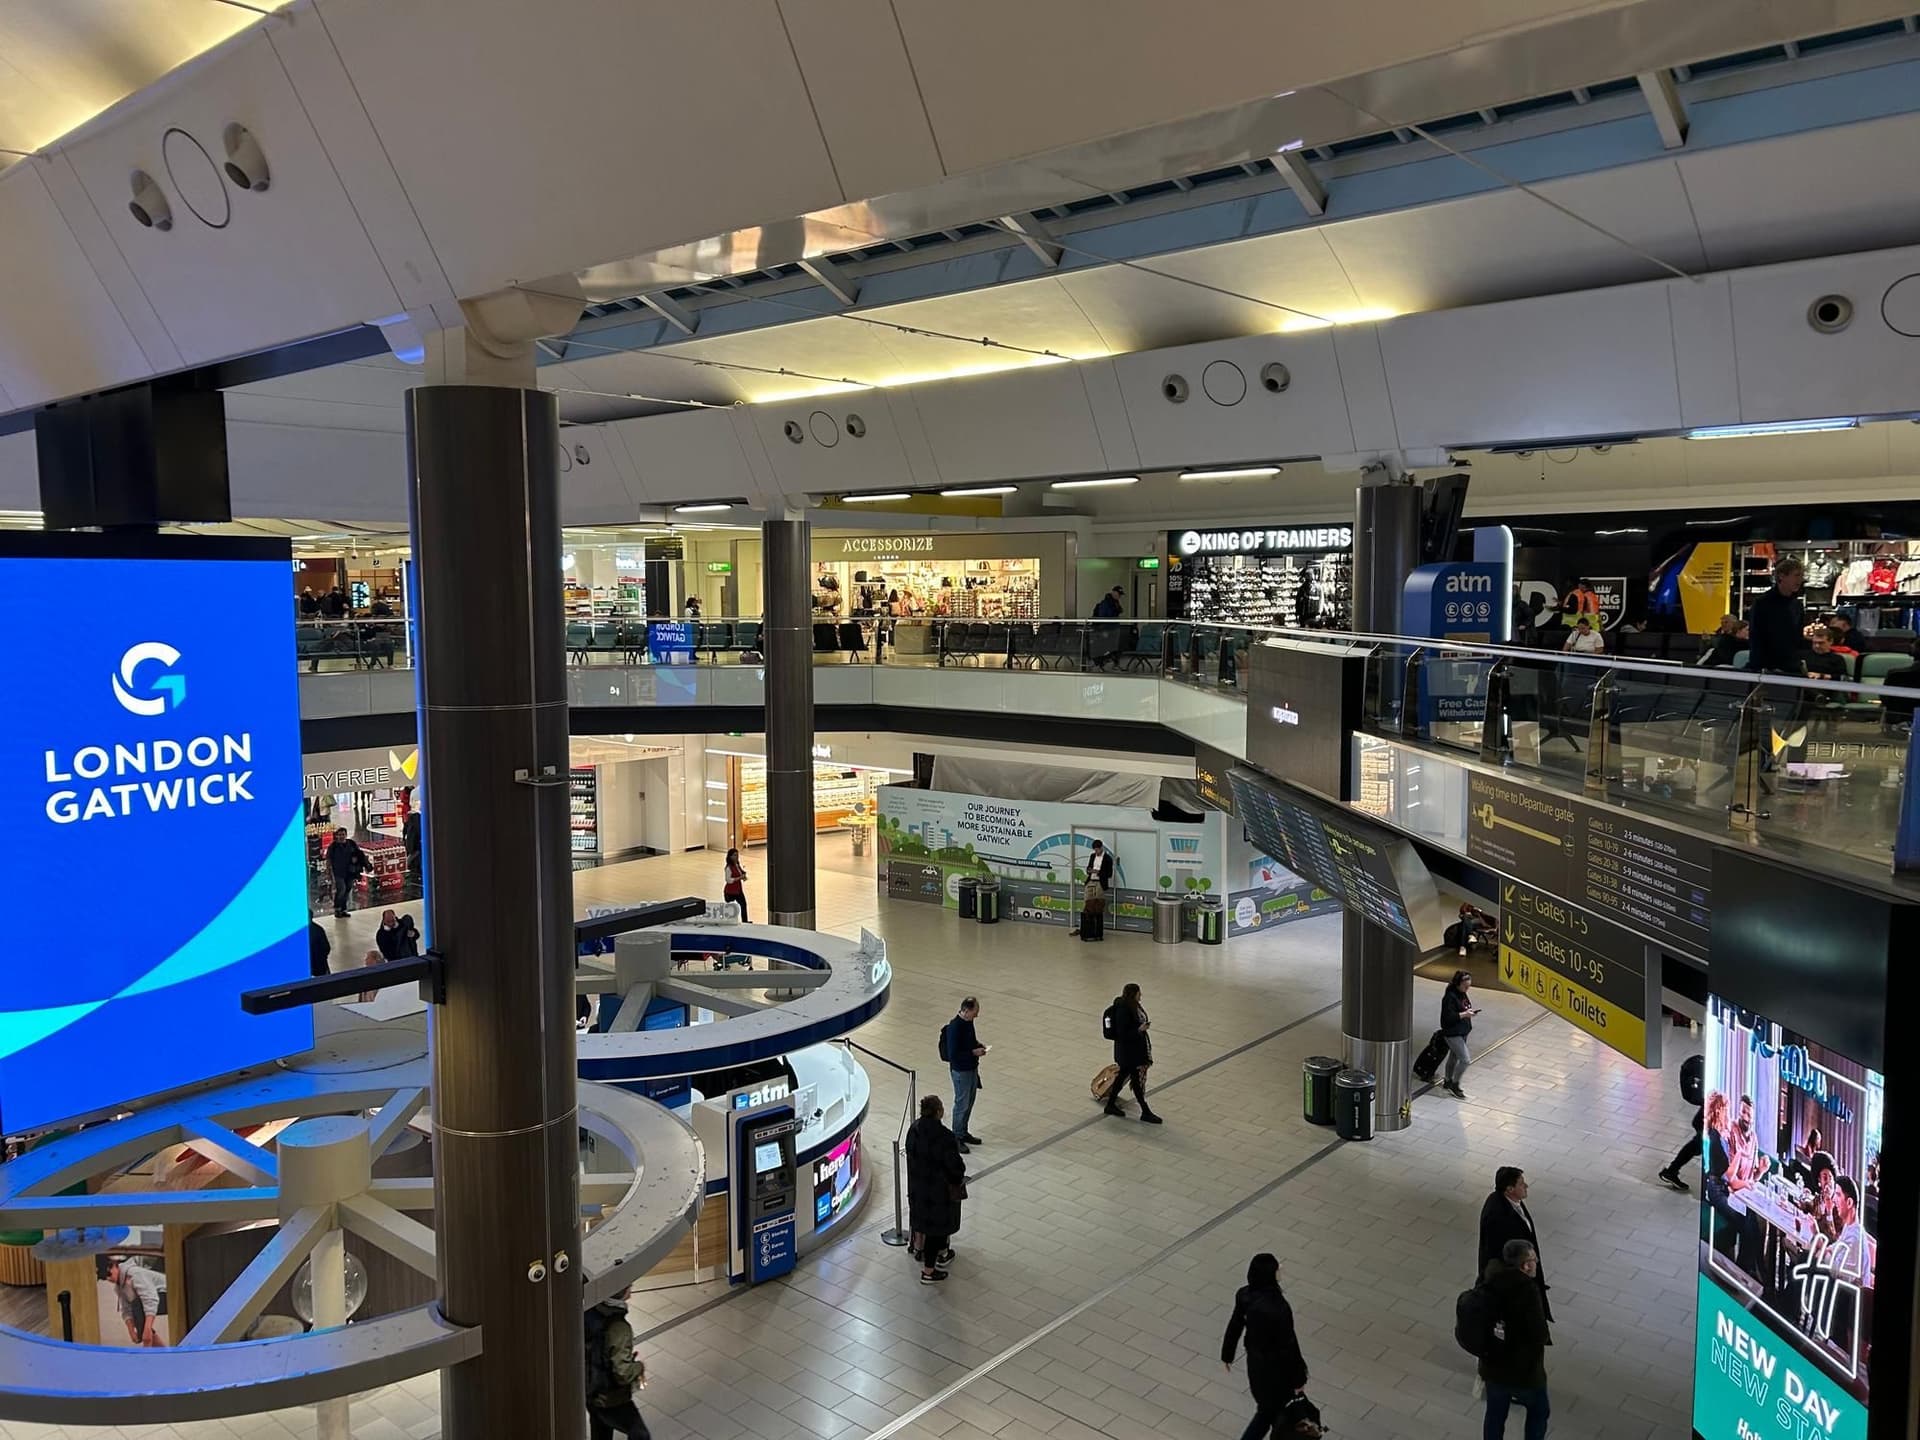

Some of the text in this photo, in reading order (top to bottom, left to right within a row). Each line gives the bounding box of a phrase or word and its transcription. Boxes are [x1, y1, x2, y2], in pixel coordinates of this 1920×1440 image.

[842, 537, 934, 552] ACCESSORIZE
[1201, 528, 1352, 550] KING OF TRAINERS
[1446, 572, 1492, 592] atm
[1438, 698, 1487, 709] Free Cas
[45, 732, 251, 782] LONDON
[336, 766, 390, 788] FREE
[46, 770, 255, 823] GATWICK
[967, 802, 1021, 817] OUR JOURNEY
[1471, 778, 1575, 823] Walking time to Departure gates
[957, 821, 1033, 838] MORE SUSTAINABLE
[964, 812, 1026, 828] TO BECOMING A
[1588, 817, 1603, 831] Gates
[1605, 822, 1614, 833] 1-5
[1624, 830, 1632, 840] 2-5
[1633, 833, 1654, 847] minutes
[976, 834, 1011, 846] GATWICK
[1588, 834, 1602, 848] Gates
[1623, 848, 1632, 858] 2-6
[1633, 851, 1654, 866] minutes
[1587, 852, 1602, 865] Gates
[1623, 866, 1632, 876] 5-9
[1632, 869, 1653, 884] minutes
[1587, 869, 1601, 883] Gates
[1622, 884, 1631, 894] 6-8
[1632, 888, 1652, 902] minutes
[1535, 895, 1588, 935] Gates 1-5
[1586, 886, 1601, 899] Gates
[1622, 901, 1631, 912] 2-4
[1631, 905, 1651, 921] minutes
[1535, 932, 1604, 984] Gates 10-95
[1567, 988, 1607, 1028] Toilets
[749, 1084, 789, 1107] atm
[820, 1153, 845, 1183] here
[1711, 1337, 1769, 1406] NEW
[1717, 1310, 1841, 1433] NEW DAY
